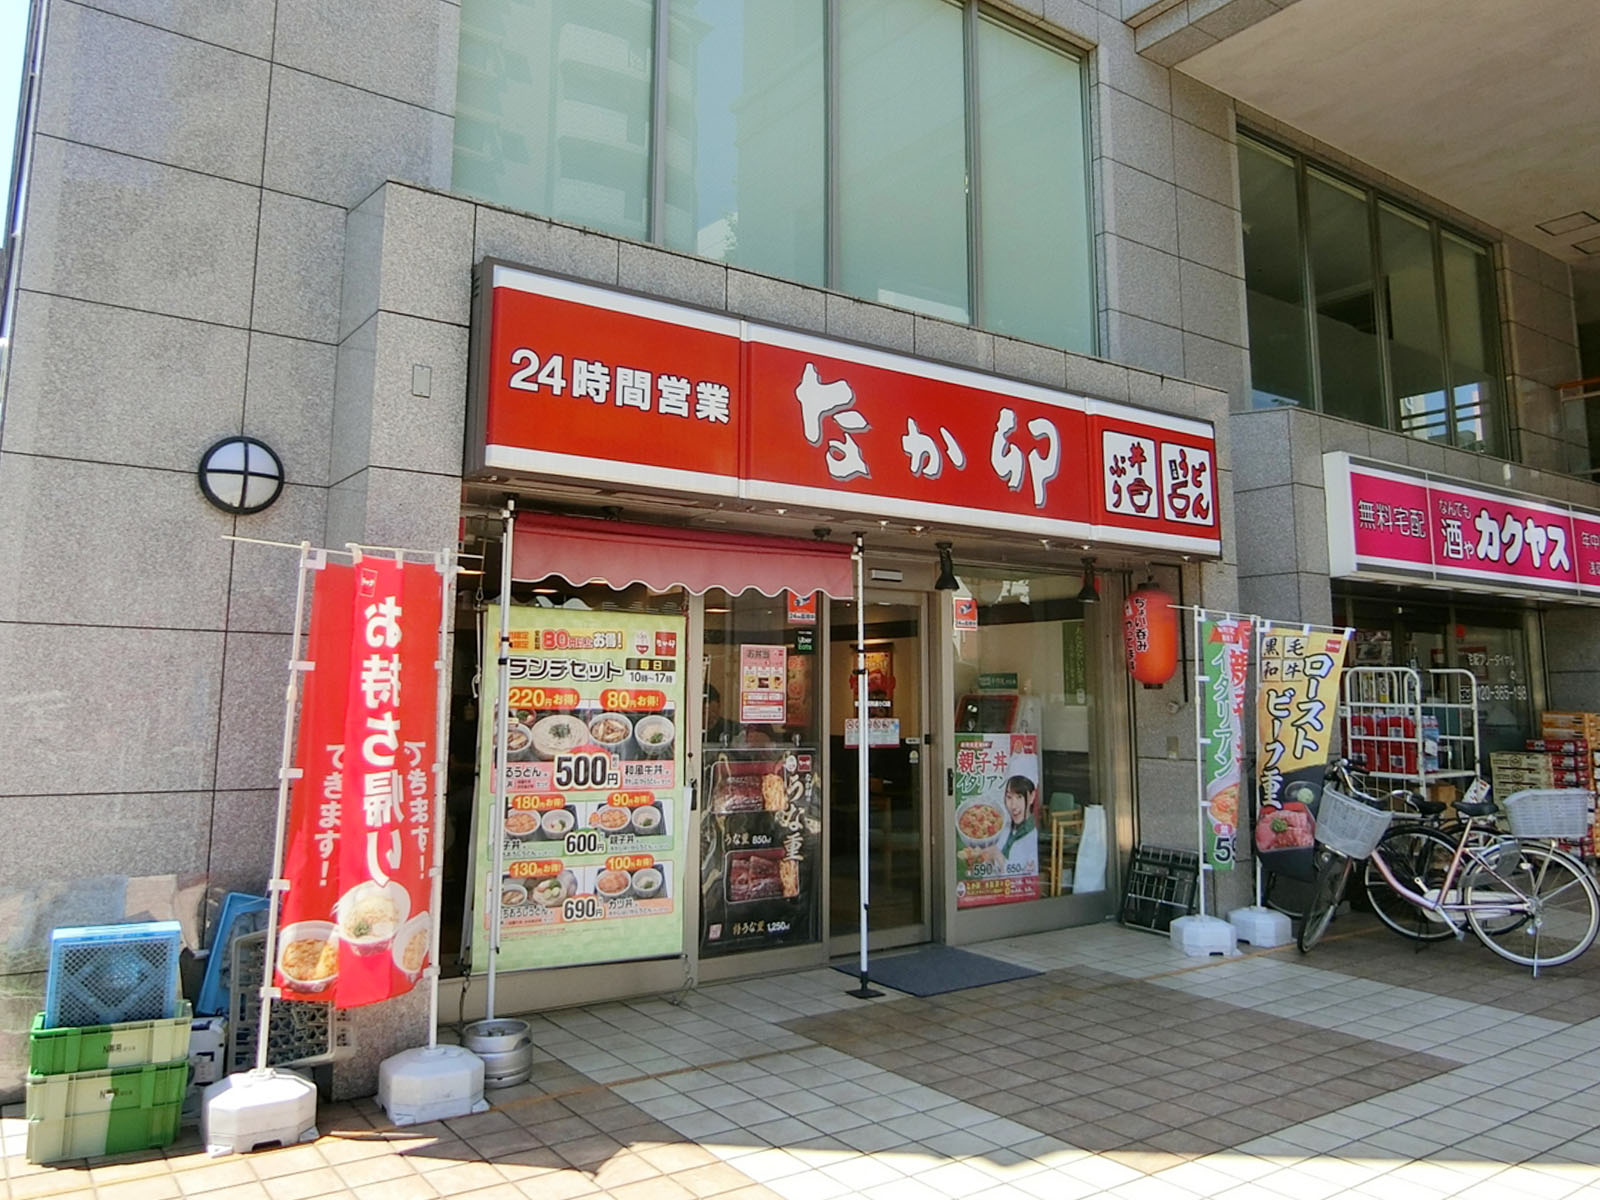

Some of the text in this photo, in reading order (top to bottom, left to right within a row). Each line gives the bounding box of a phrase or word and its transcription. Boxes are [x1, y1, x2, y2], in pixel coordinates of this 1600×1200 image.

[508, 347, 730, 425] 24時間営業
[796, 361, 1060, 508] なか卯
[1357, 499, 1427, 538] 無料宅配
[1438, 499, 1472, 519] なんでも
[1474, 508, 1571, 573] カクヤス
[509, 657, 622, 681] ランチセット
[1210, 645, 1233, 779] イタリアン
[1296, 653, 1334, 760] ロースト
[555, 755, 619, 787] 500円
[958, 750, 1008, 773] 親子丼
[1260, 687, 1297, 811] ビーフ重
[502, 839, 521, 851] 子丼
[783, 773, 804, 861] うな重
